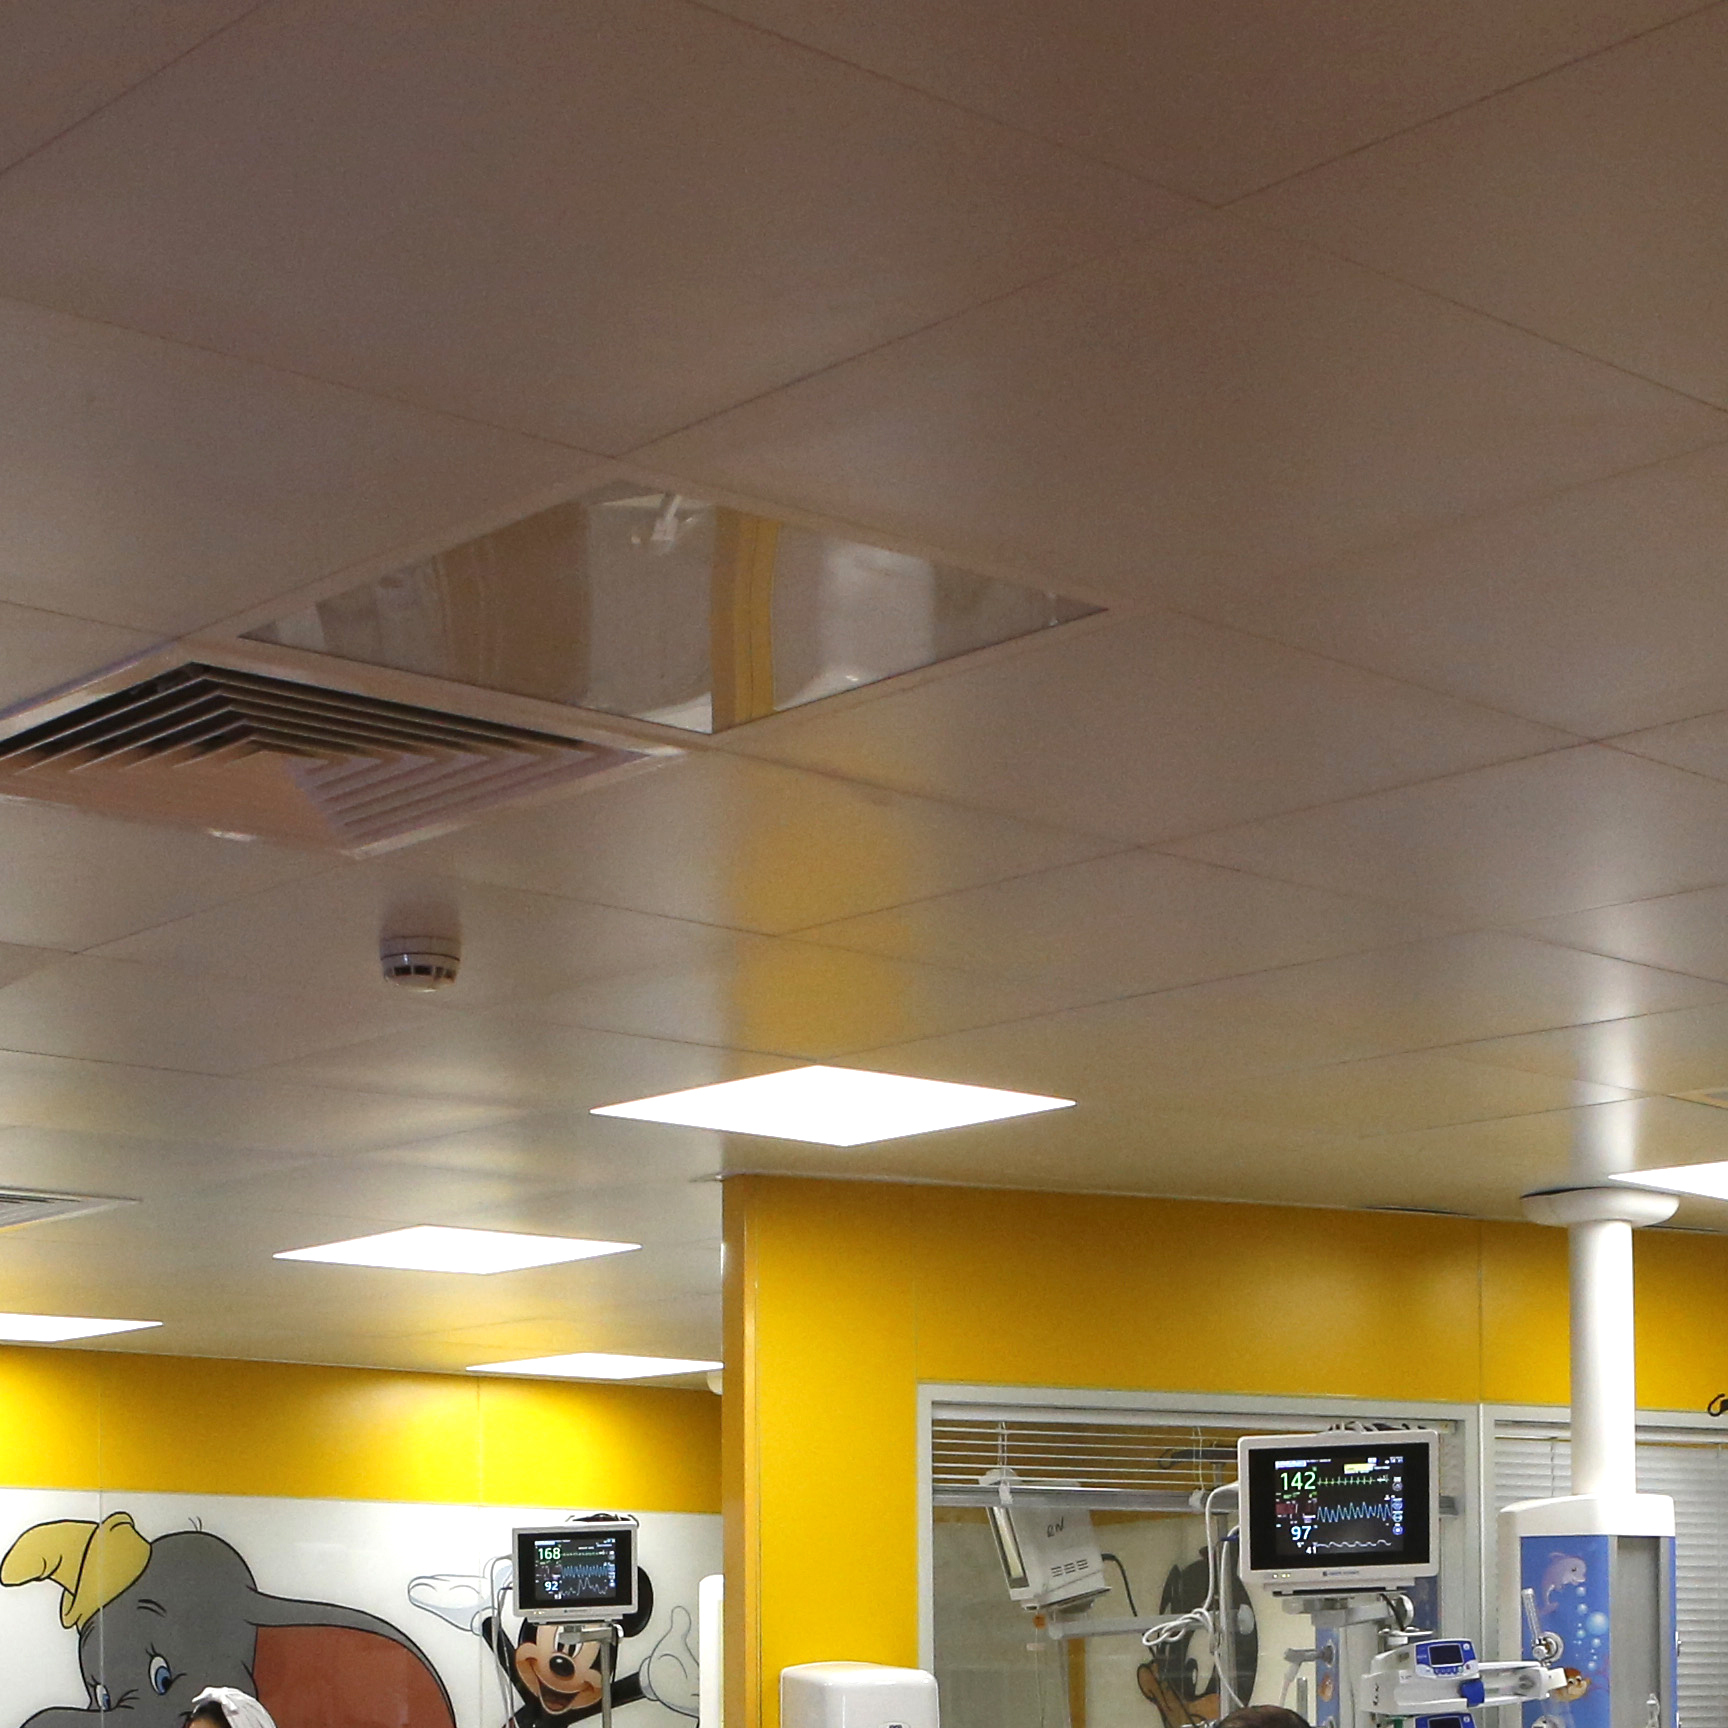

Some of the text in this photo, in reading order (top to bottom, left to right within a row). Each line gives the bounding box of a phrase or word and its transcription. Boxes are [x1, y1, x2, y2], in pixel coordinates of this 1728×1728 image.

[1280, 1471, 1317, 1491] 142
[1291, 1525, 1312, 1541] 97
[538, 1547, 561, 1560] 168
[544, 1581, 559, 1591] 92
